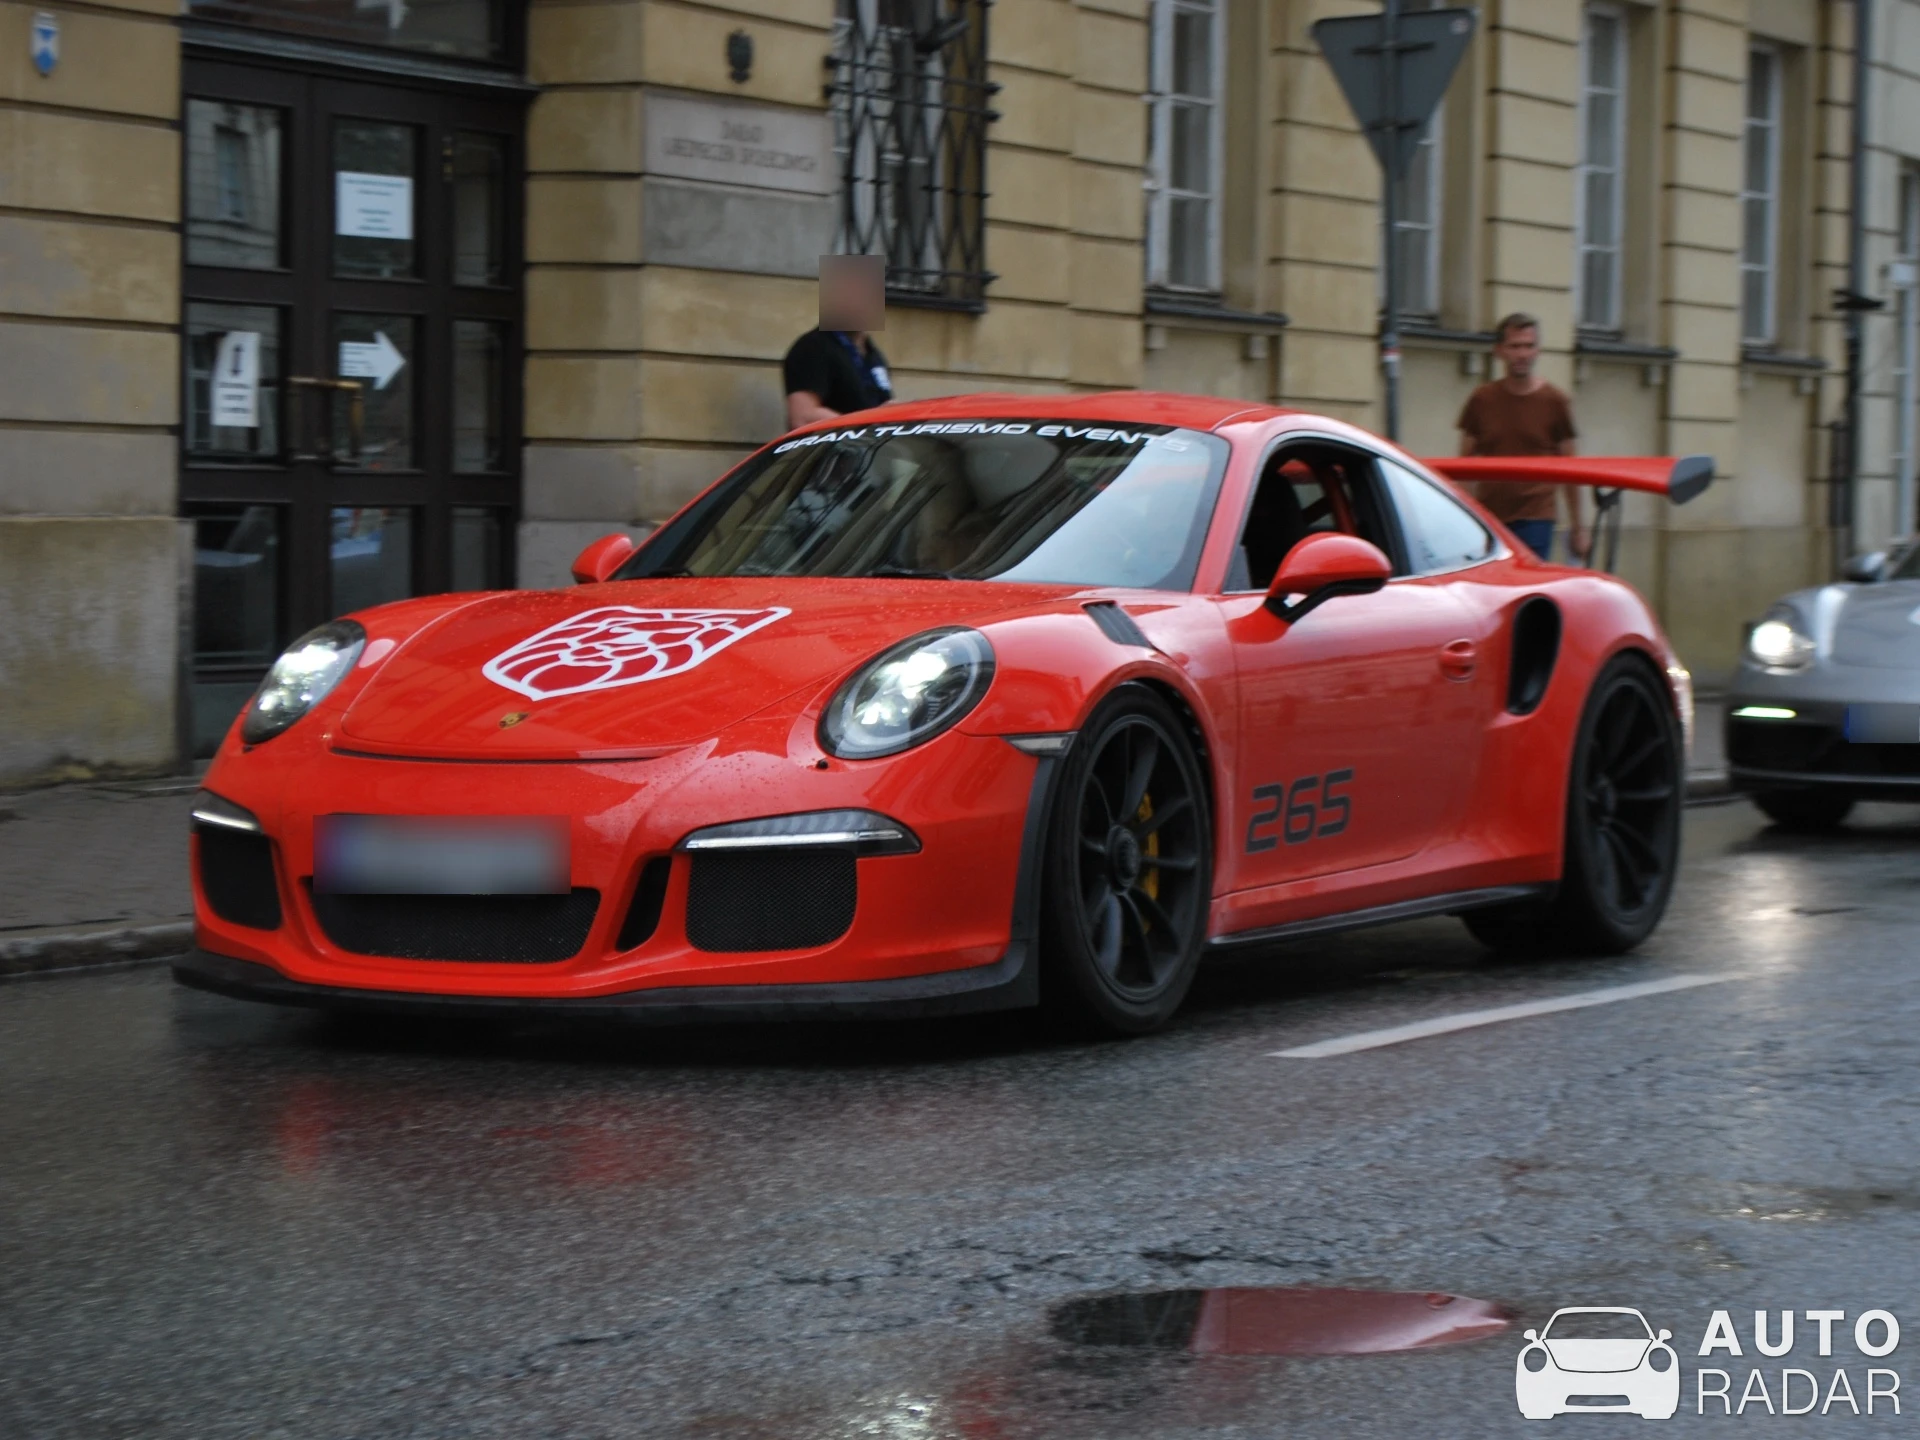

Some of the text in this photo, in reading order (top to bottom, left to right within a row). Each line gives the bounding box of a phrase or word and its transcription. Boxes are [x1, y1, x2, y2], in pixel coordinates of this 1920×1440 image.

[773, 423, 1191, 454] GRAN TURISMO EVENTS
[1245, 767, 1355, 854] 265
